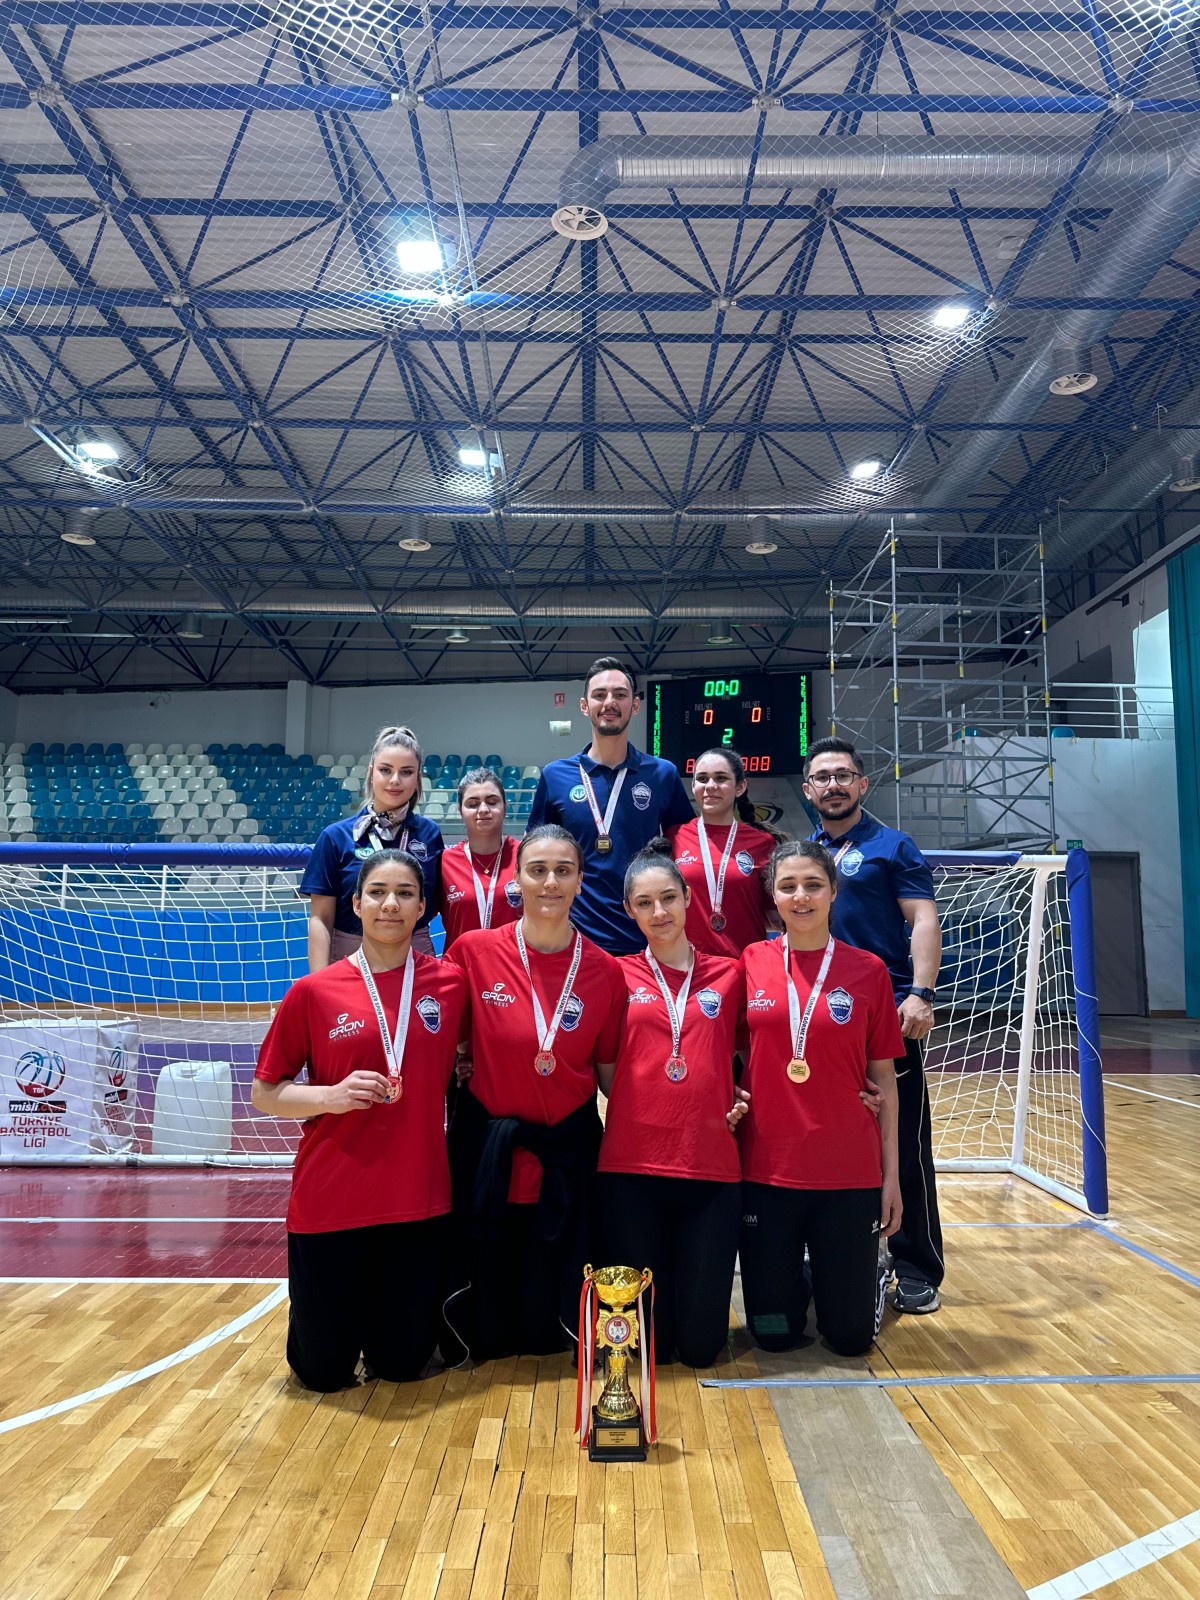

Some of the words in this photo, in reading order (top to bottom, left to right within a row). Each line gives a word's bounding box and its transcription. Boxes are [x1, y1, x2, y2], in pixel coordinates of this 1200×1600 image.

[704, 680, 739, 696] 00:0
[704, 710, 713, 724] 0
[752, 707, 761, 722] 0
[722, 728, 733, 744] 2
[482, 991, 516, 1003] GRON
[748, 999, 776, 1007] GRON
[329, 1020, 364, 1039] GRON
[800, 1016, 808, 1035] GÖRME
[378, 1015, 391, 1054] FEDERASYONU
[12, 1115, 62, 1126] TÜRKİYE
[0, 1127, 71, 1136] BASKETBOL
[24, 1137, 46, 1148] LİGİ
